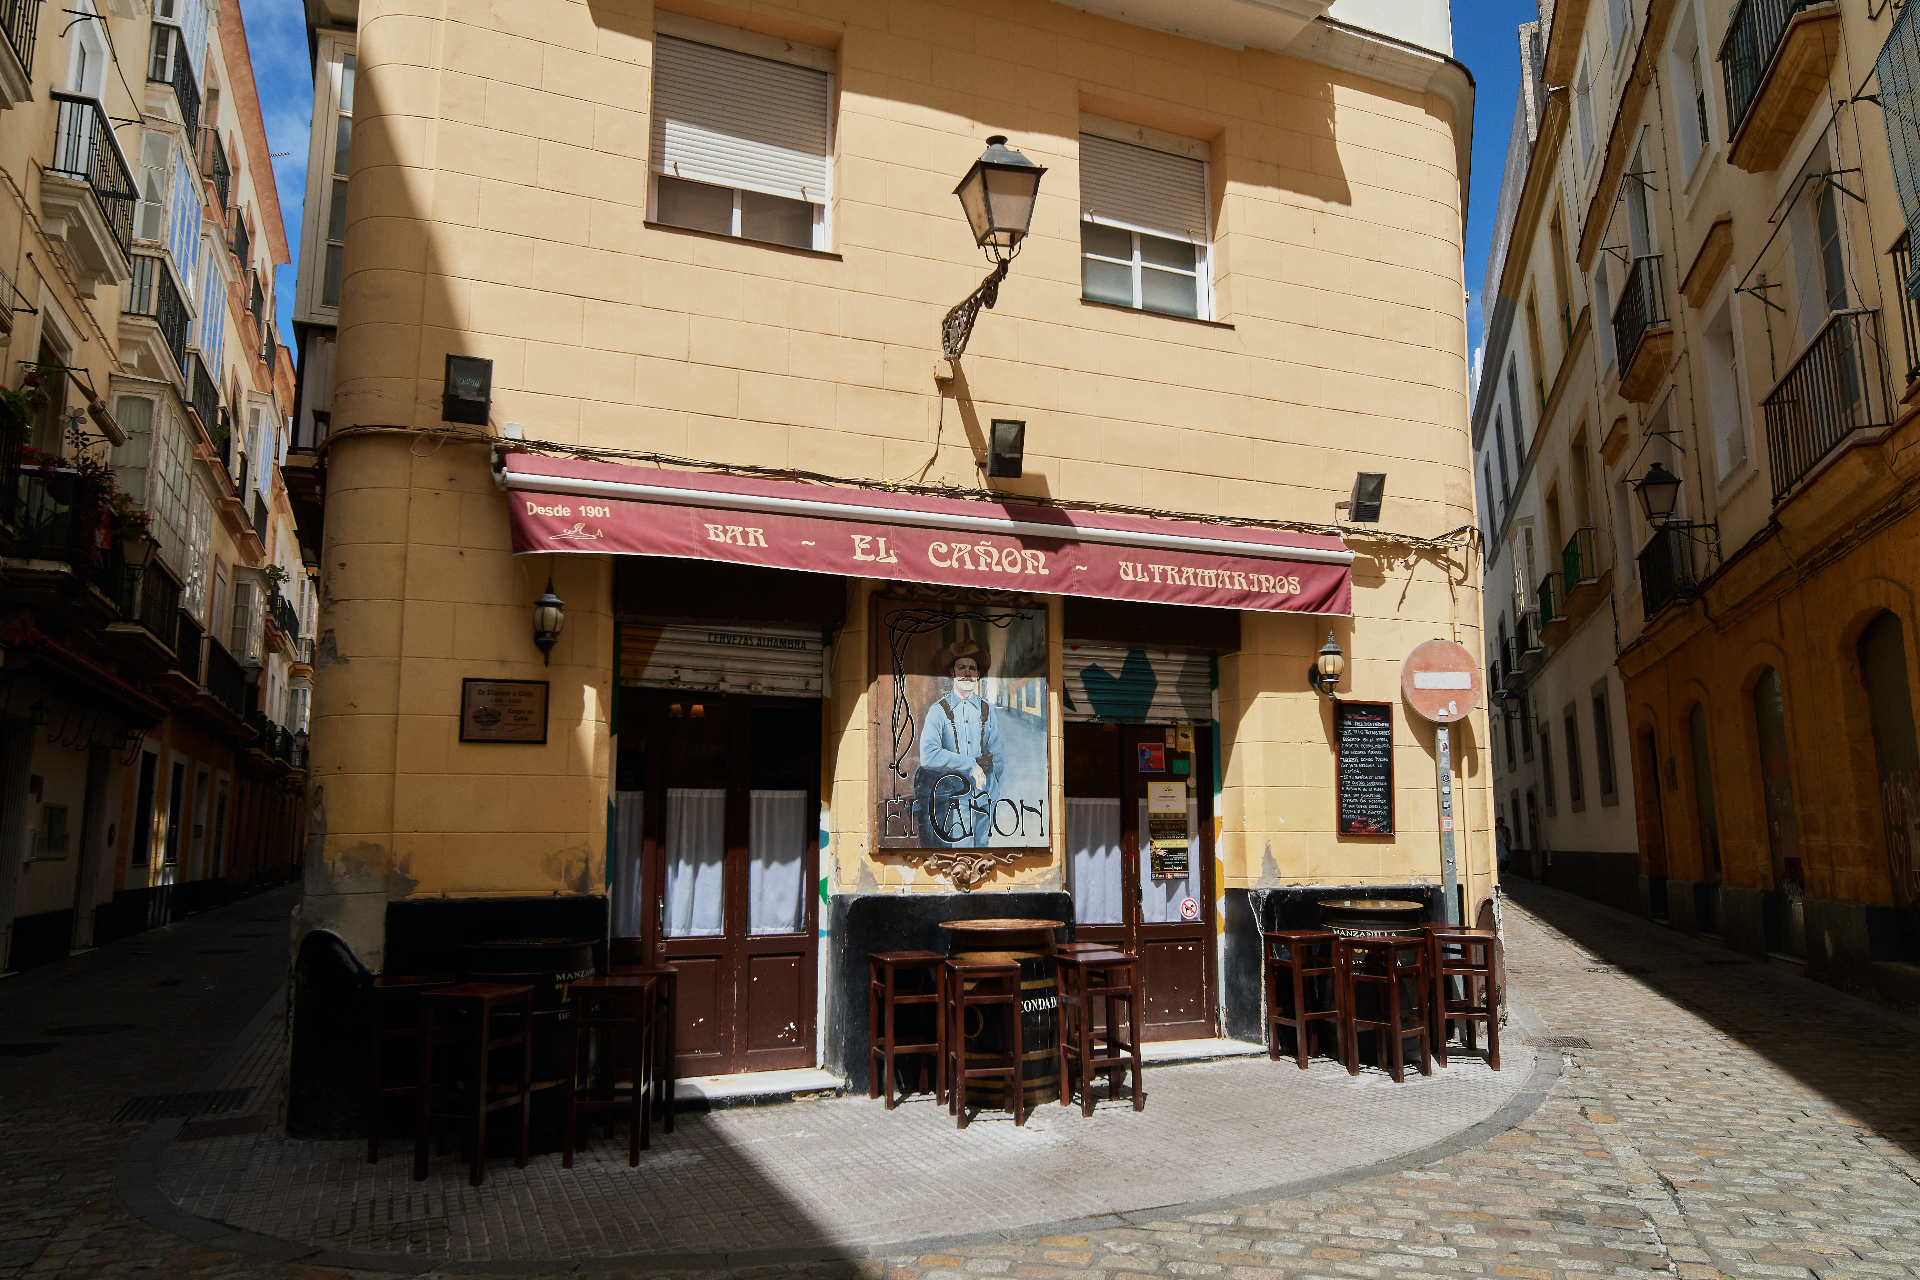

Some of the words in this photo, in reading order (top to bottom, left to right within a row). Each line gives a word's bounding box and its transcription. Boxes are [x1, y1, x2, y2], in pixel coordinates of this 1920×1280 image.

[526, 501, 572, 517] Desde
[579, 505, 611, 518] 1901
[704, 523, 768, 548] BAR
[851, 534, 898, 563] EL
[927, 540, 1050, 576] CAÑON
[1118, 561, 1301, 596] ULTRAMARINOS
[708, 632, 754, 647] CERVEZAS
[756, 636, 807, 651] ALHAMBRA
[1020, 995, 1060, 1014] CONDAD
